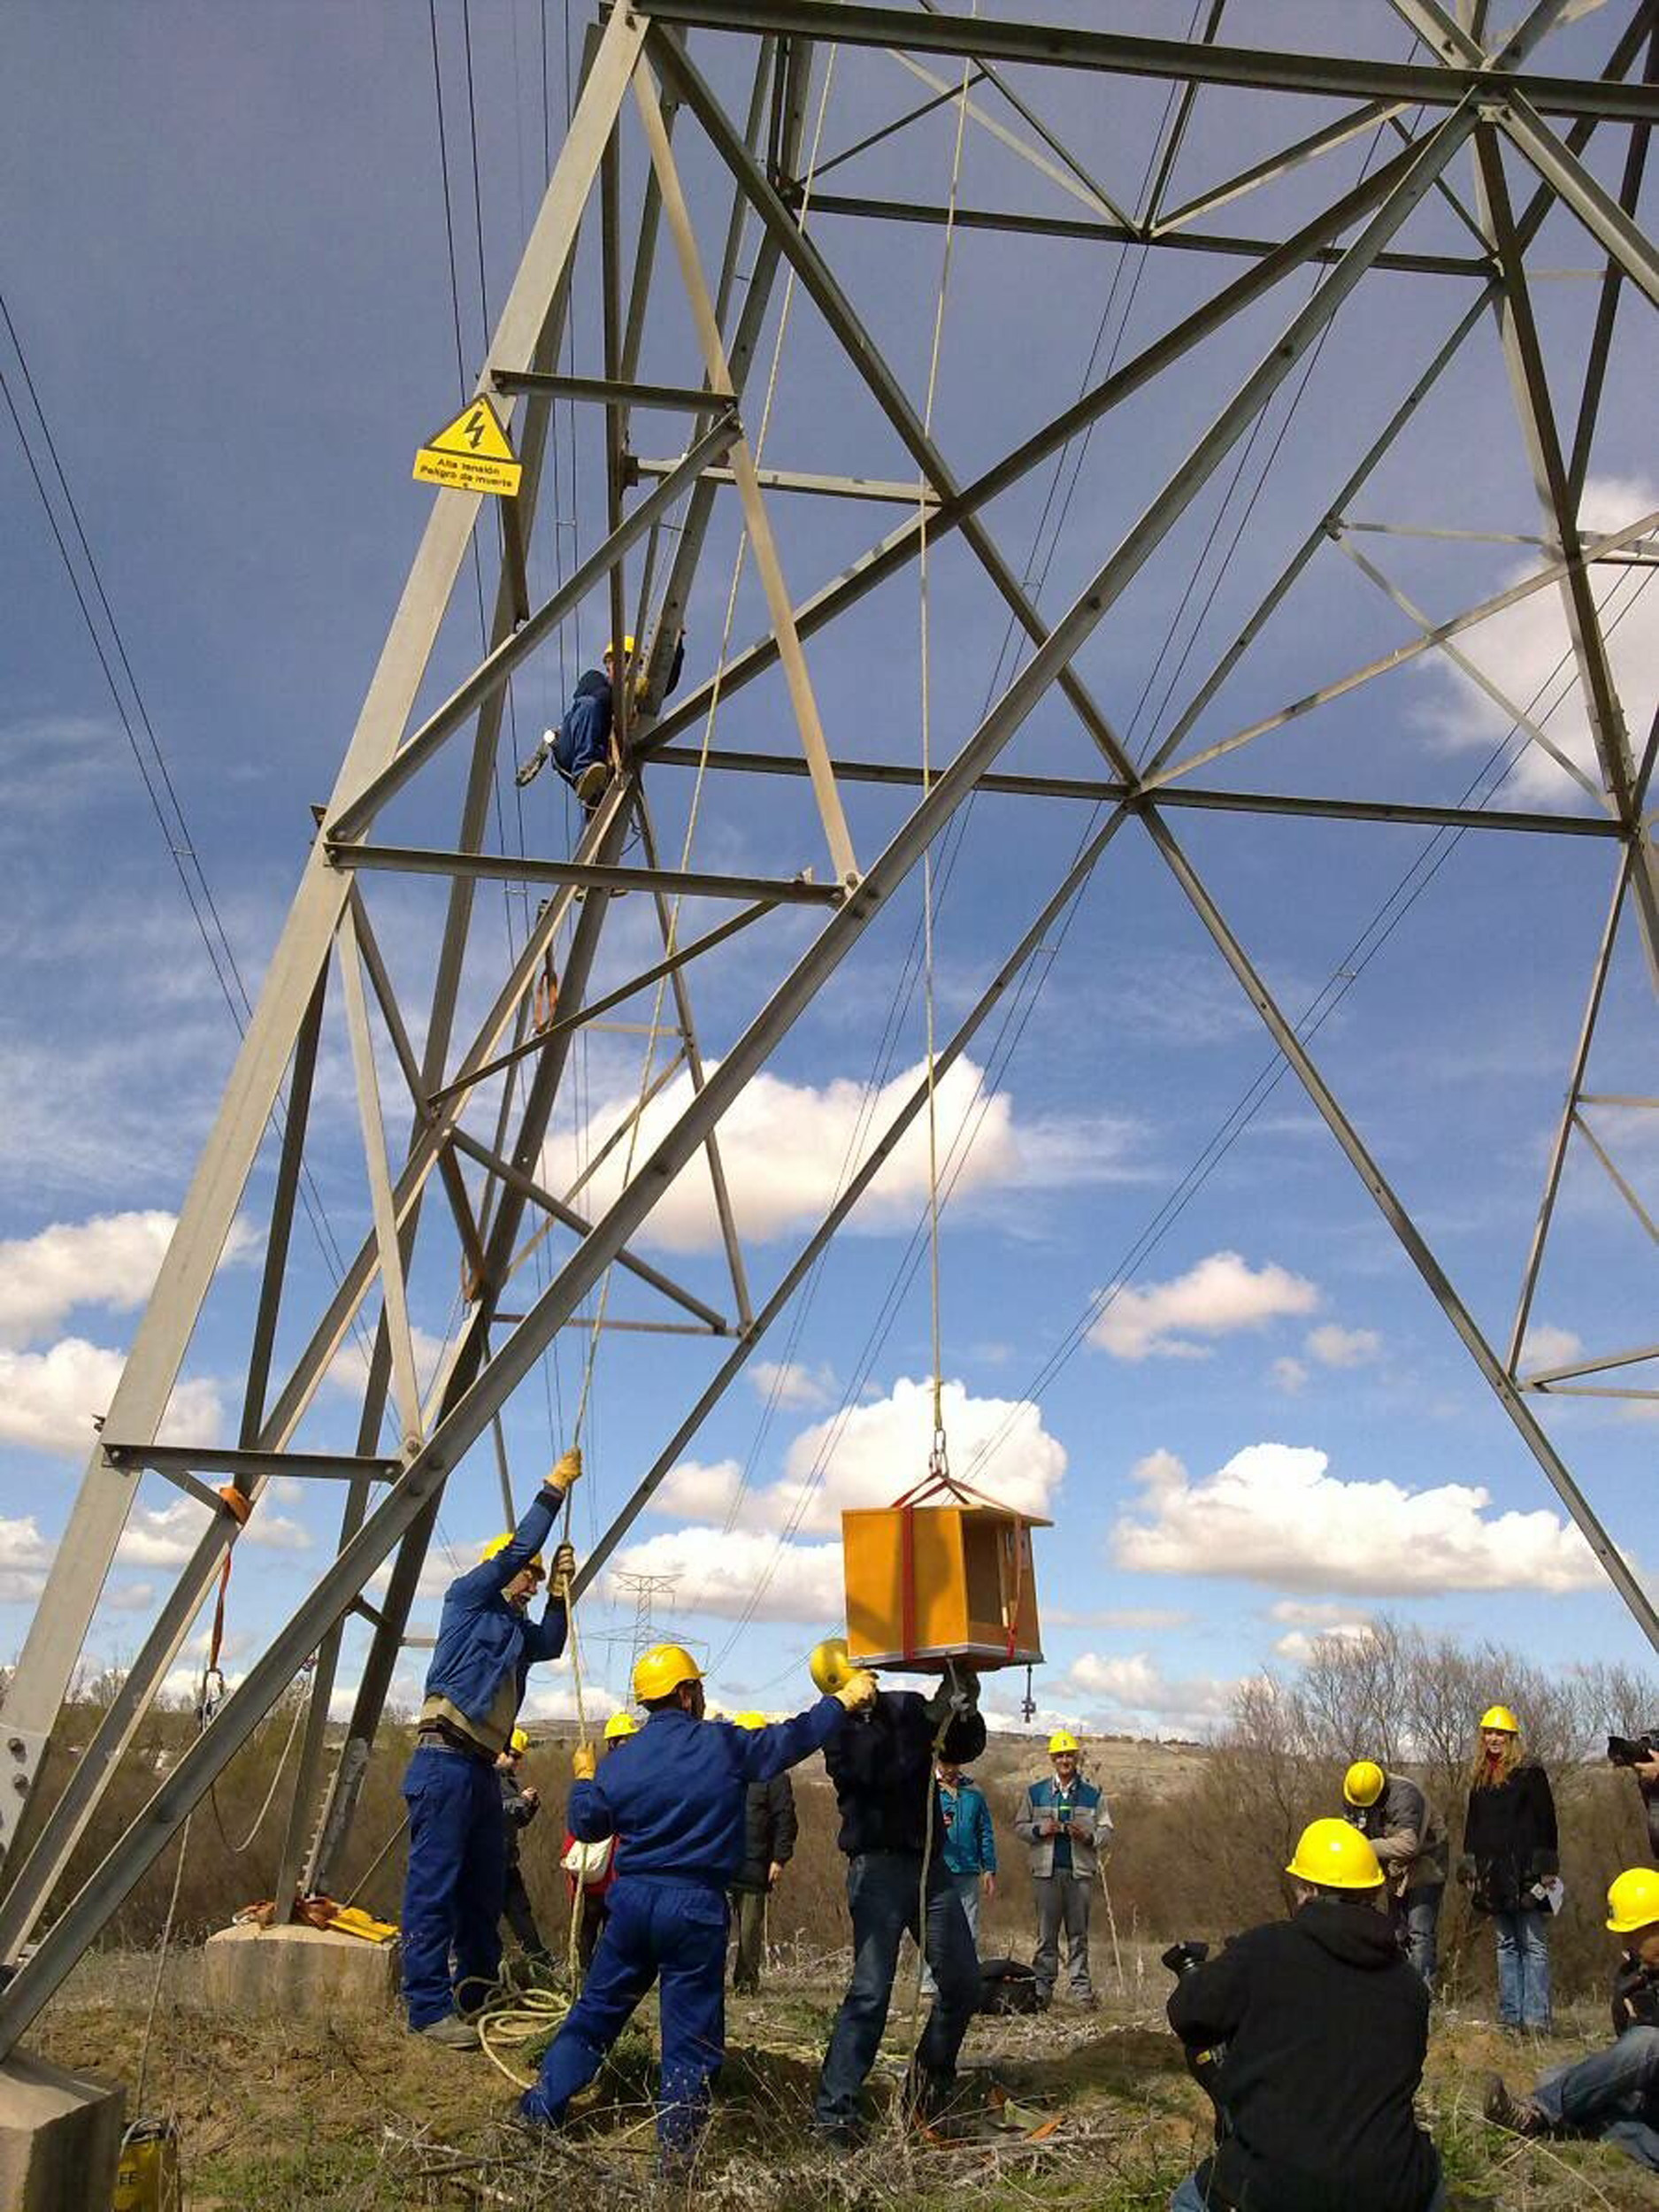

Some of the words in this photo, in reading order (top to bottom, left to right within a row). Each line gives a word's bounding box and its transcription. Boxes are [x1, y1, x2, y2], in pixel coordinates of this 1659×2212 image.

[420, 465, 457, 479] Peligro
[460, 472, 472, 481] de
[475, 475, 512, 488] muerte
[437, 458, 457, 469] Alta
[462, 463, 500, 475] tensión
